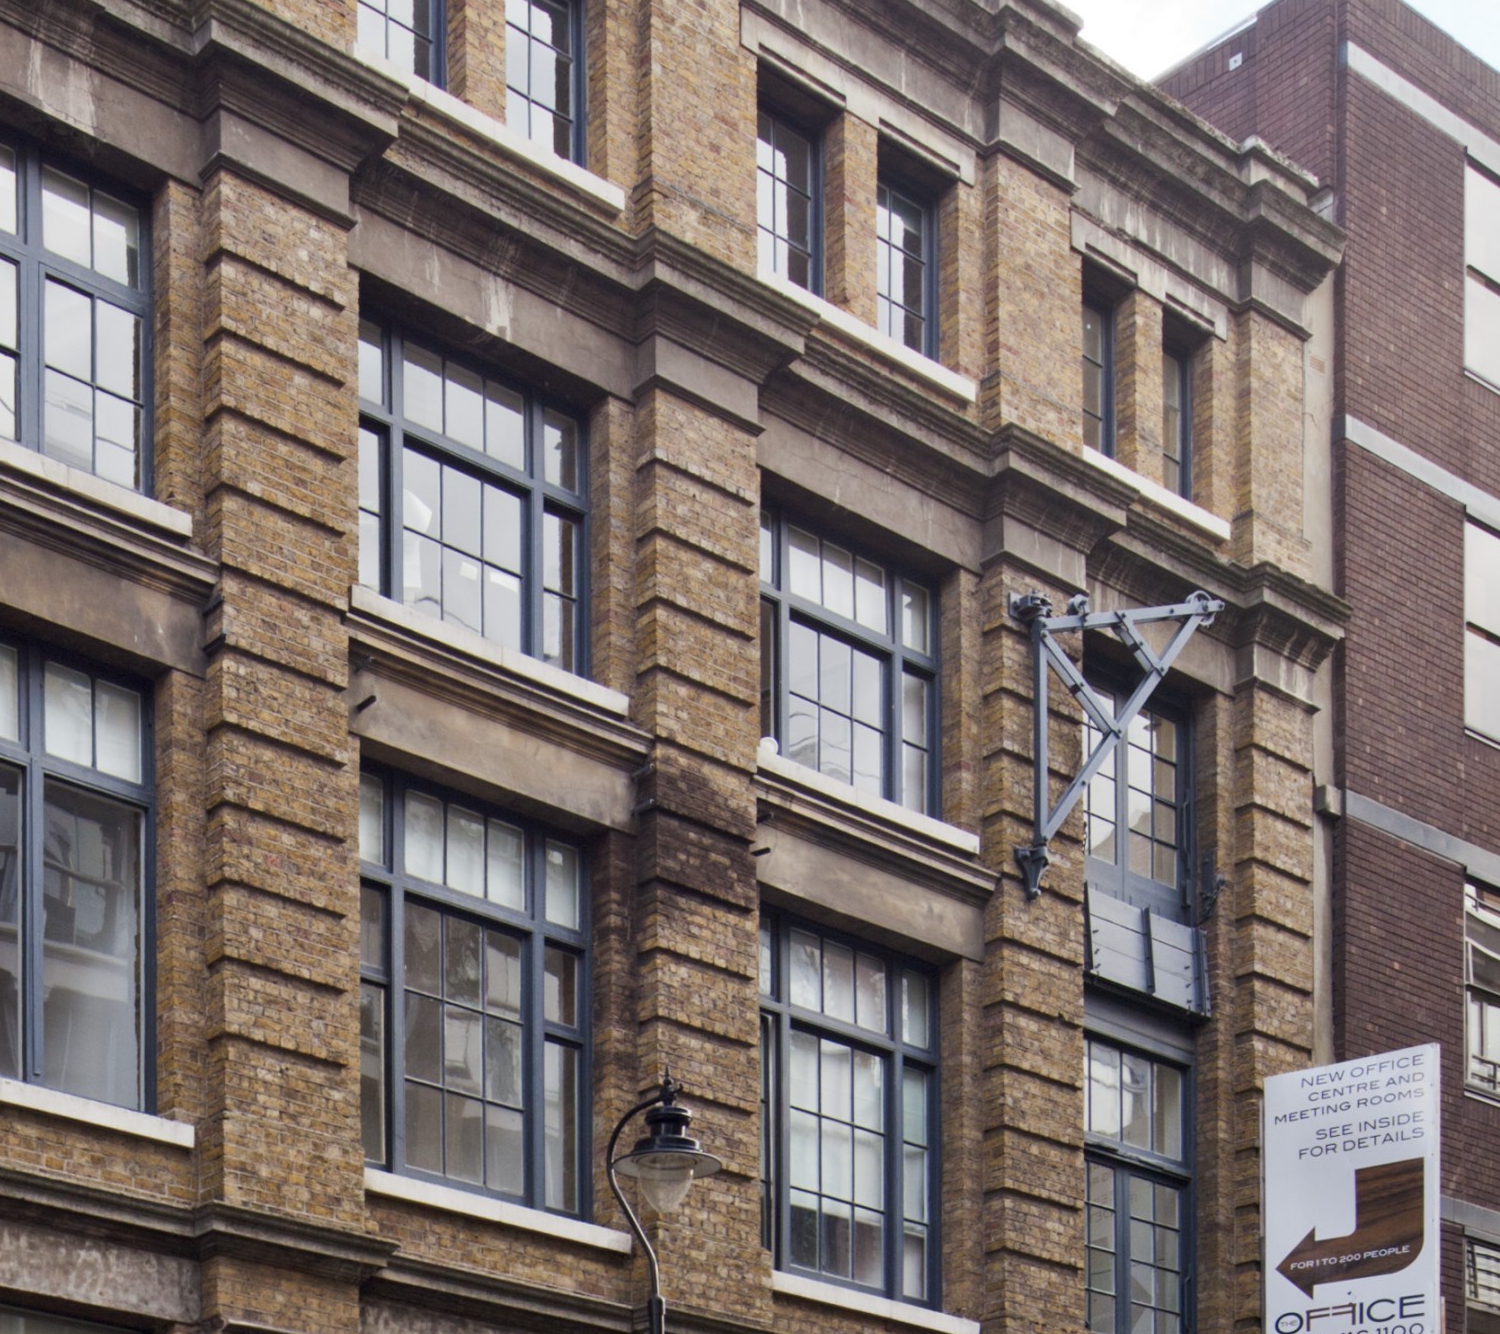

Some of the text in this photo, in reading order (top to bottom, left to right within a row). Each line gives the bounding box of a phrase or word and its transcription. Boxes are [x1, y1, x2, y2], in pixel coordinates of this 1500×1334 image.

[1301, 1054, 1424, 1088] NEW OFFICE
[1308, 1072, 1425, 1102] CENTRE AND
[1274, 1088, 1425, 1125] MEETING ROOMS
[1315, 1110, 1425, 1141] SEE INSIDE
[1298, 1127, 1425, 1160] FOR DETAILS
[1290, 1260, 1314, 1271] FOR
[1321, 1256, 1338, 1267] TO
[1339, 1252, 1361, 1264] 200
[1363, 1244, 1410, 1260] PEOPLE
[1280, 1319, 1298, 1328] THE
